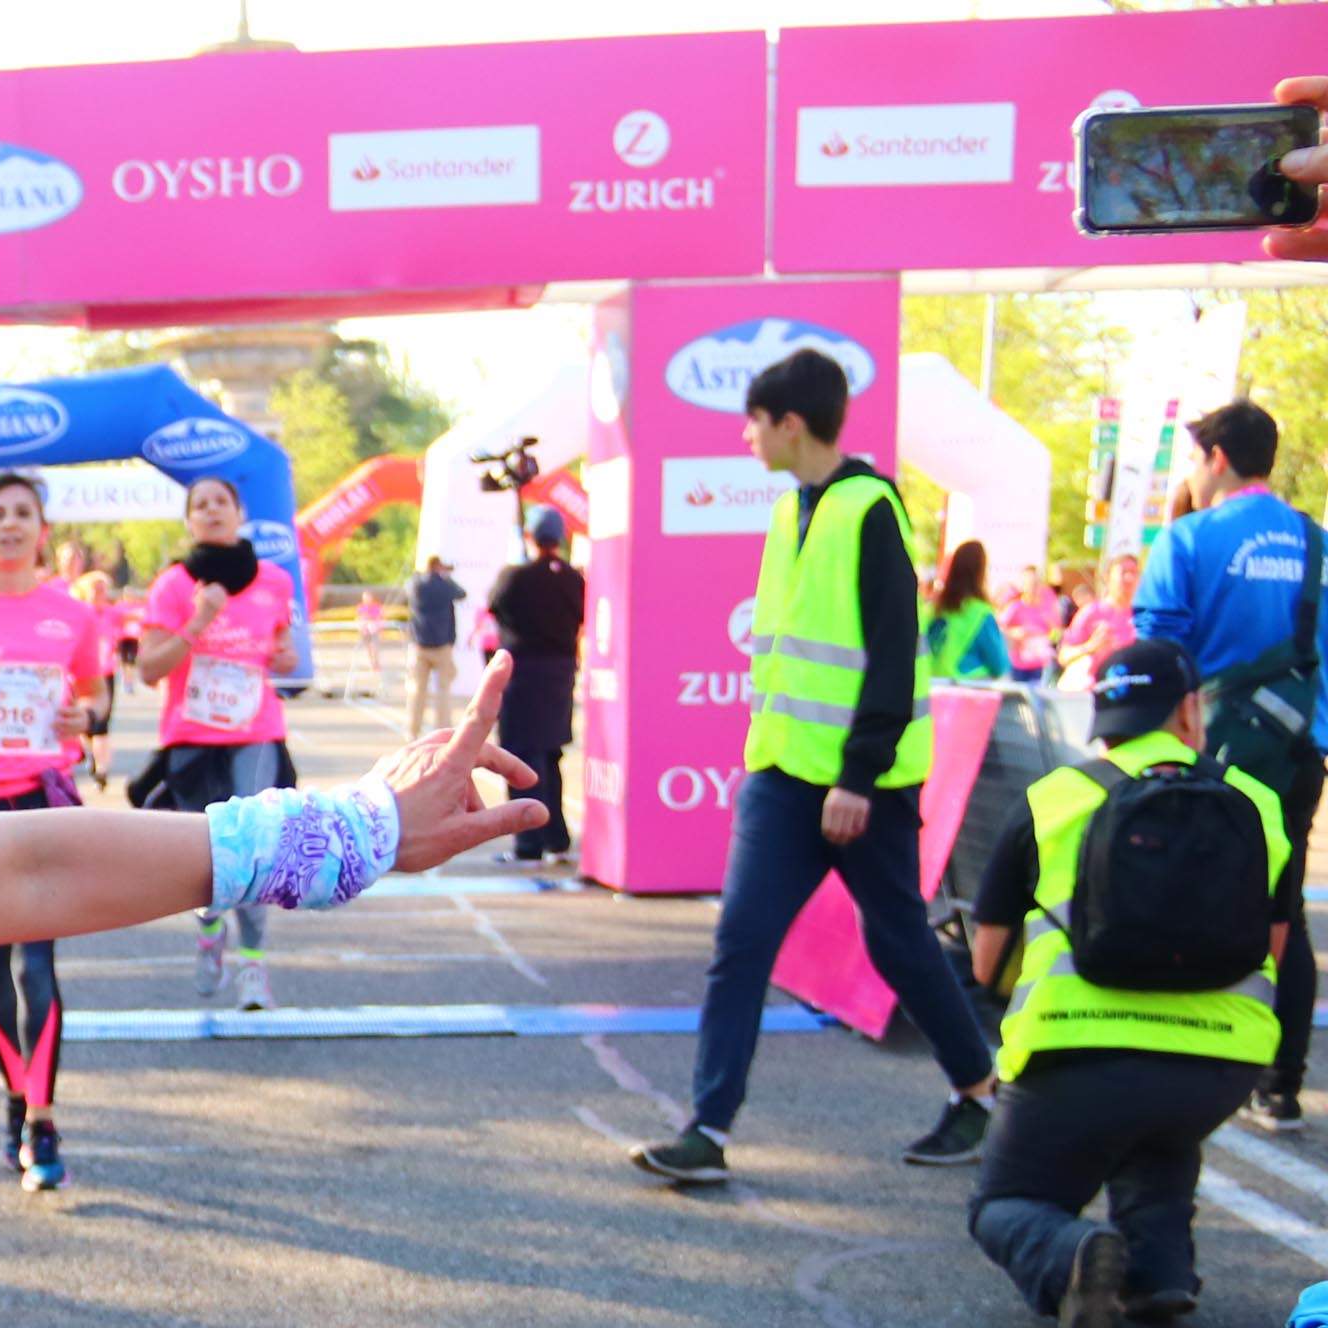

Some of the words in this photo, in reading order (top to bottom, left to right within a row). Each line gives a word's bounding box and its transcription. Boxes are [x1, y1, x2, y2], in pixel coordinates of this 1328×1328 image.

[852, 132, 989, 158] Santander
[111, 153, 303, 203] OYSHO
[385, 155, 515, 181] Santander
[568, 178, 714, 213] ZURICH
[60, 483, 176, 509] ZURICH
